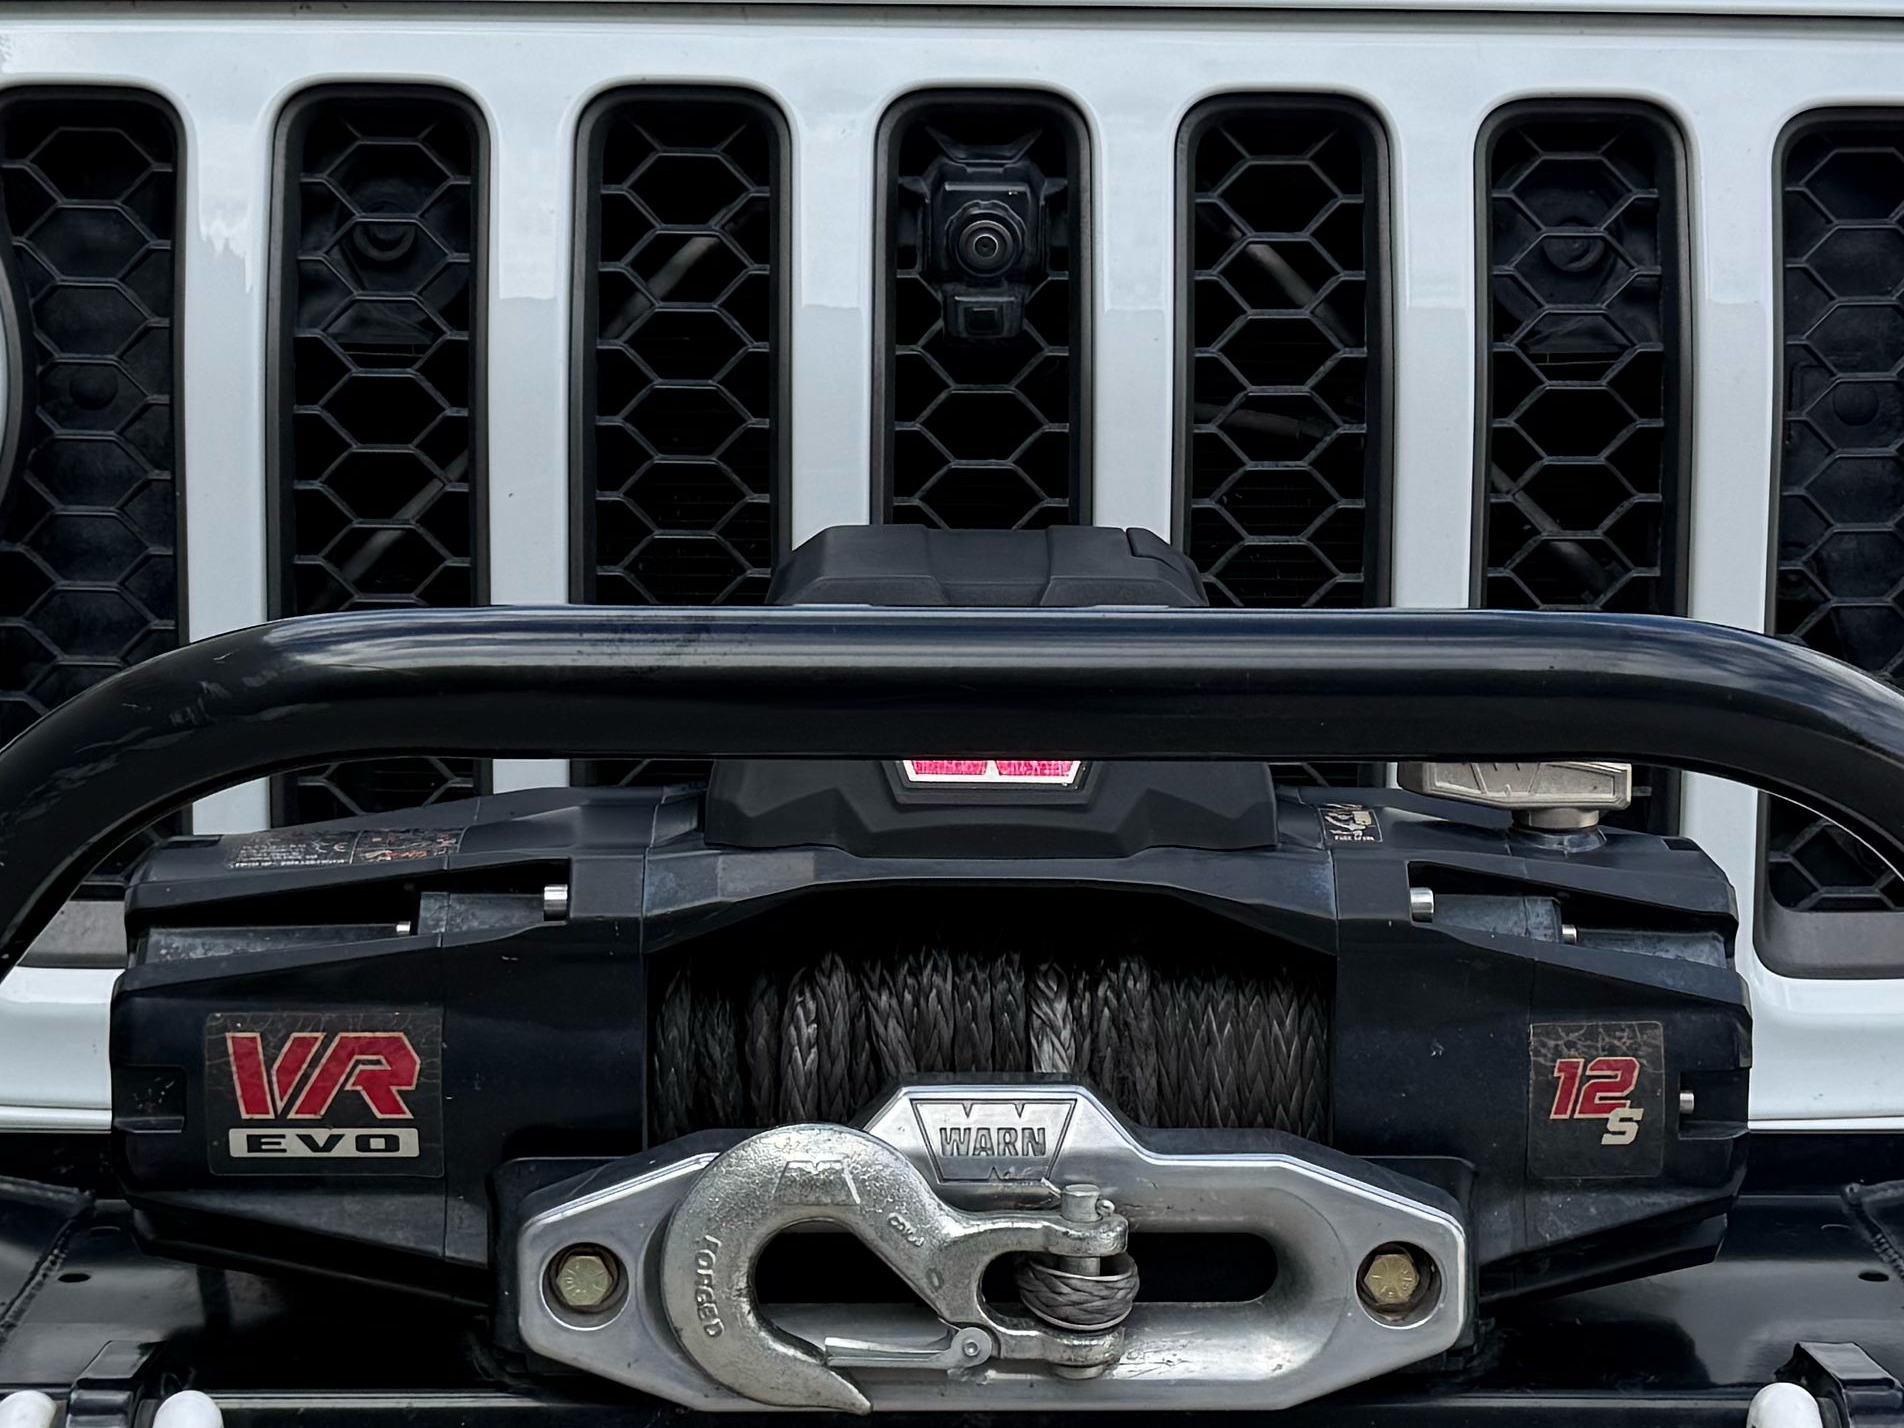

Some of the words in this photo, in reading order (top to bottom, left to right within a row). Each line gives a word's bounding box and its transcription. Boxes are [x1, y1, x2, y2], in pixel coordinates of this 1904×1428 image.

[226, 1032, 421, 1119] VR
[1550, 1057, 1640, 1119] 12
[246, 1134, 400, 1153] EVO
[939, 1127, 1046, 1157] WARN
